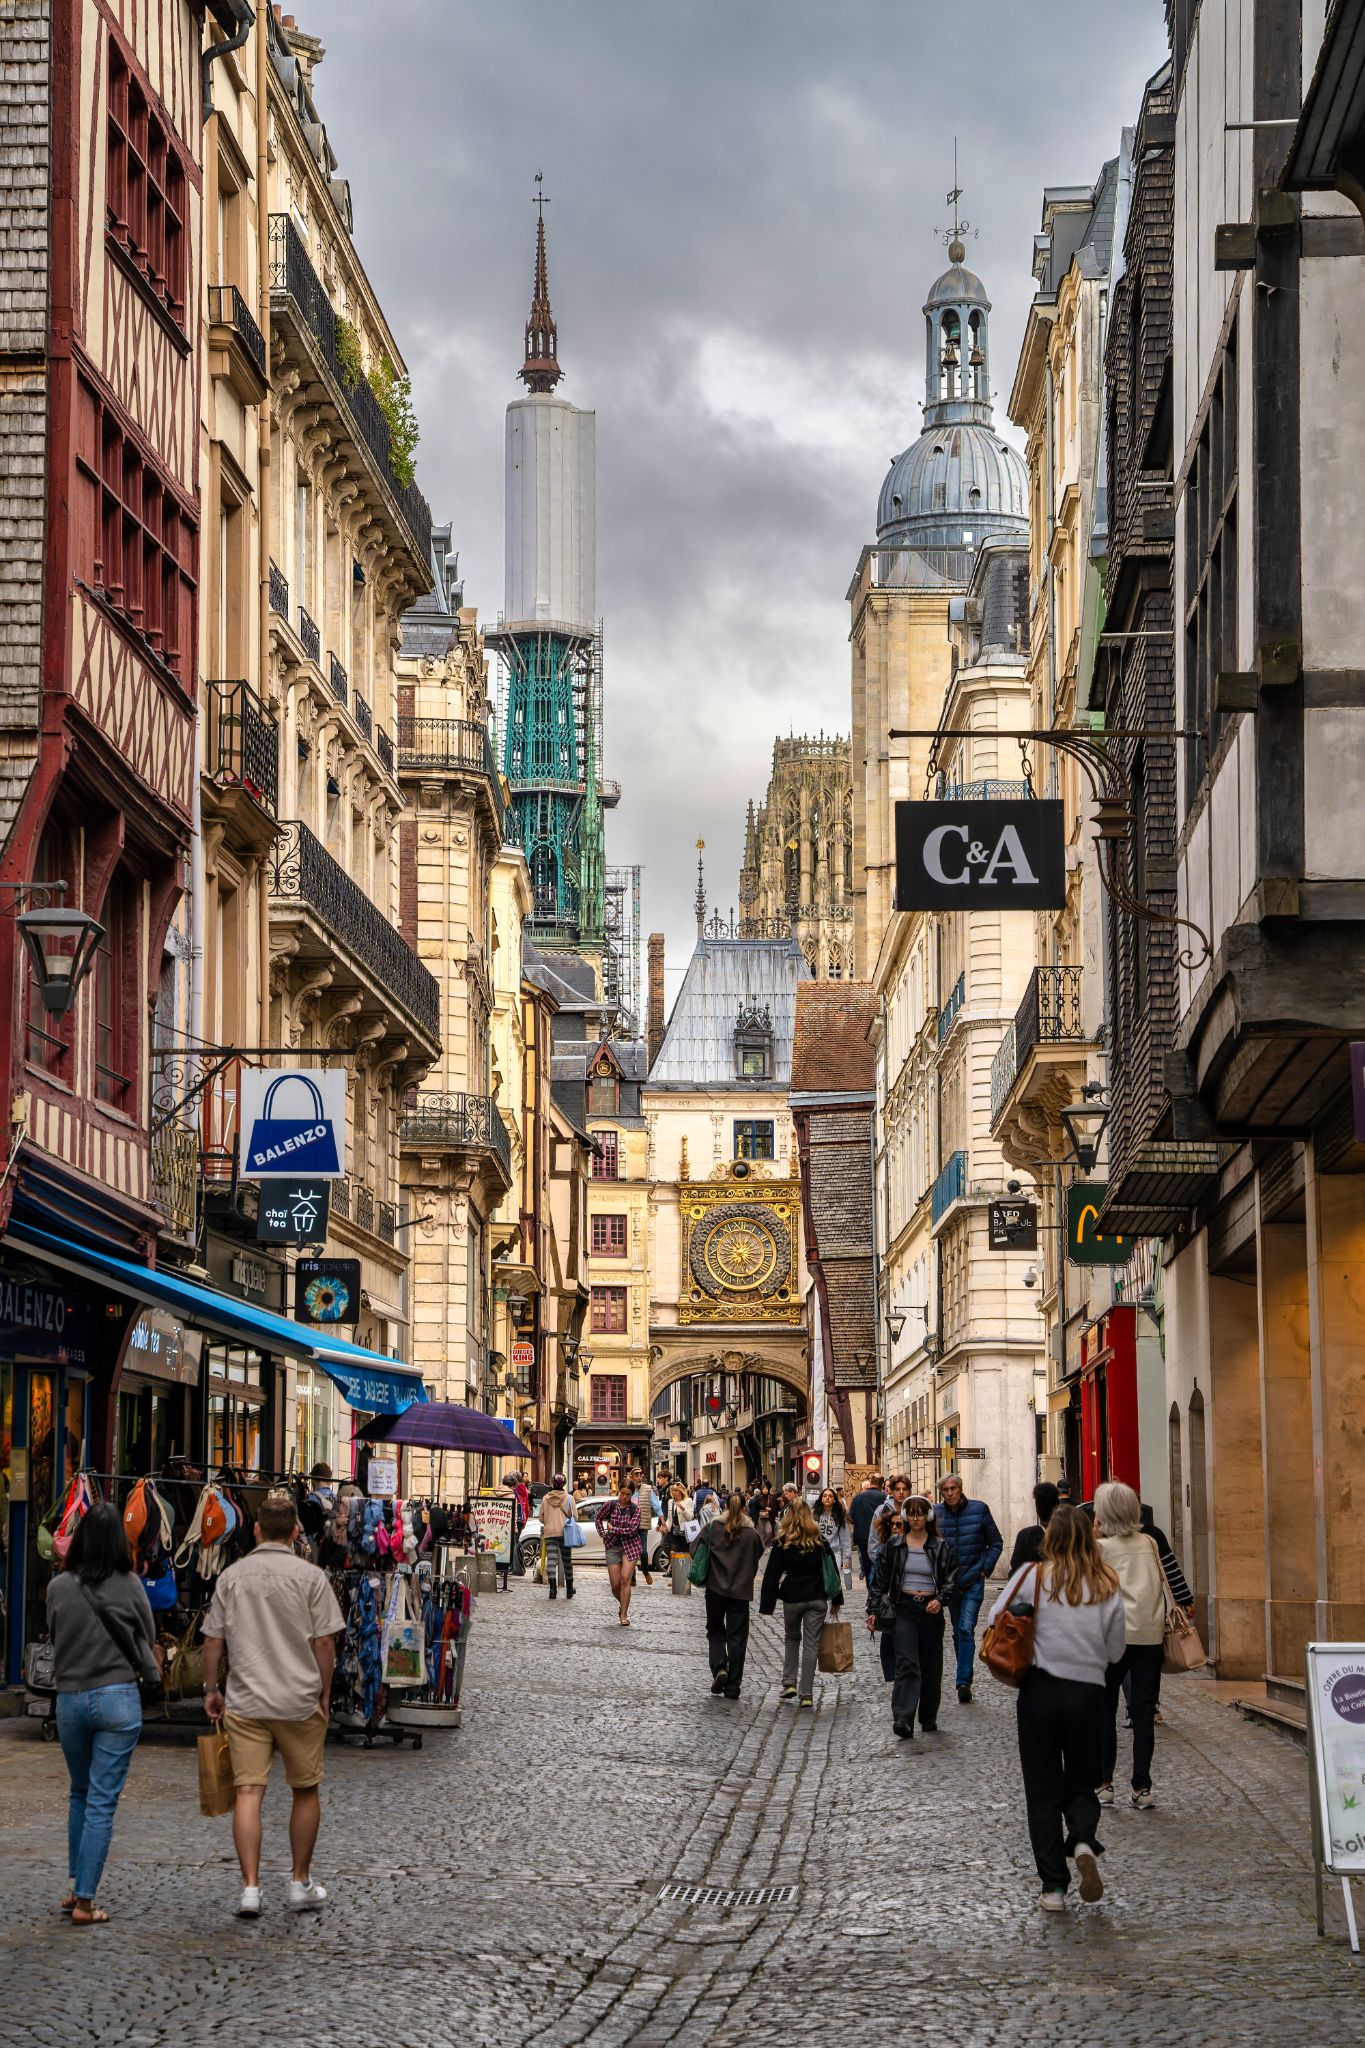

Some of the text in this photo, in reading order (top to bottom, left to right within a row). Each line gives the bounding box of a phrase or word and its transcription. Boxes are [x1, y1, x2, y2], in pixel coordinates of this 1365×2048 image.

[923, 825, 1039, 885] C&A
[253, 1125, 327, 1166] BALENZO
[265, 1208, 288, 1218] chaï
[269, 1219, 286, 1228] tea
[491, 1501, 512, 1511] PROMO
[1323, 1670, 1341, 1691] OFFRE
[1342, 1665, 1354, 1674] DU
[1334, 1696, 1344, 1704] La
[1340, 1705, 1350, 1713] du
